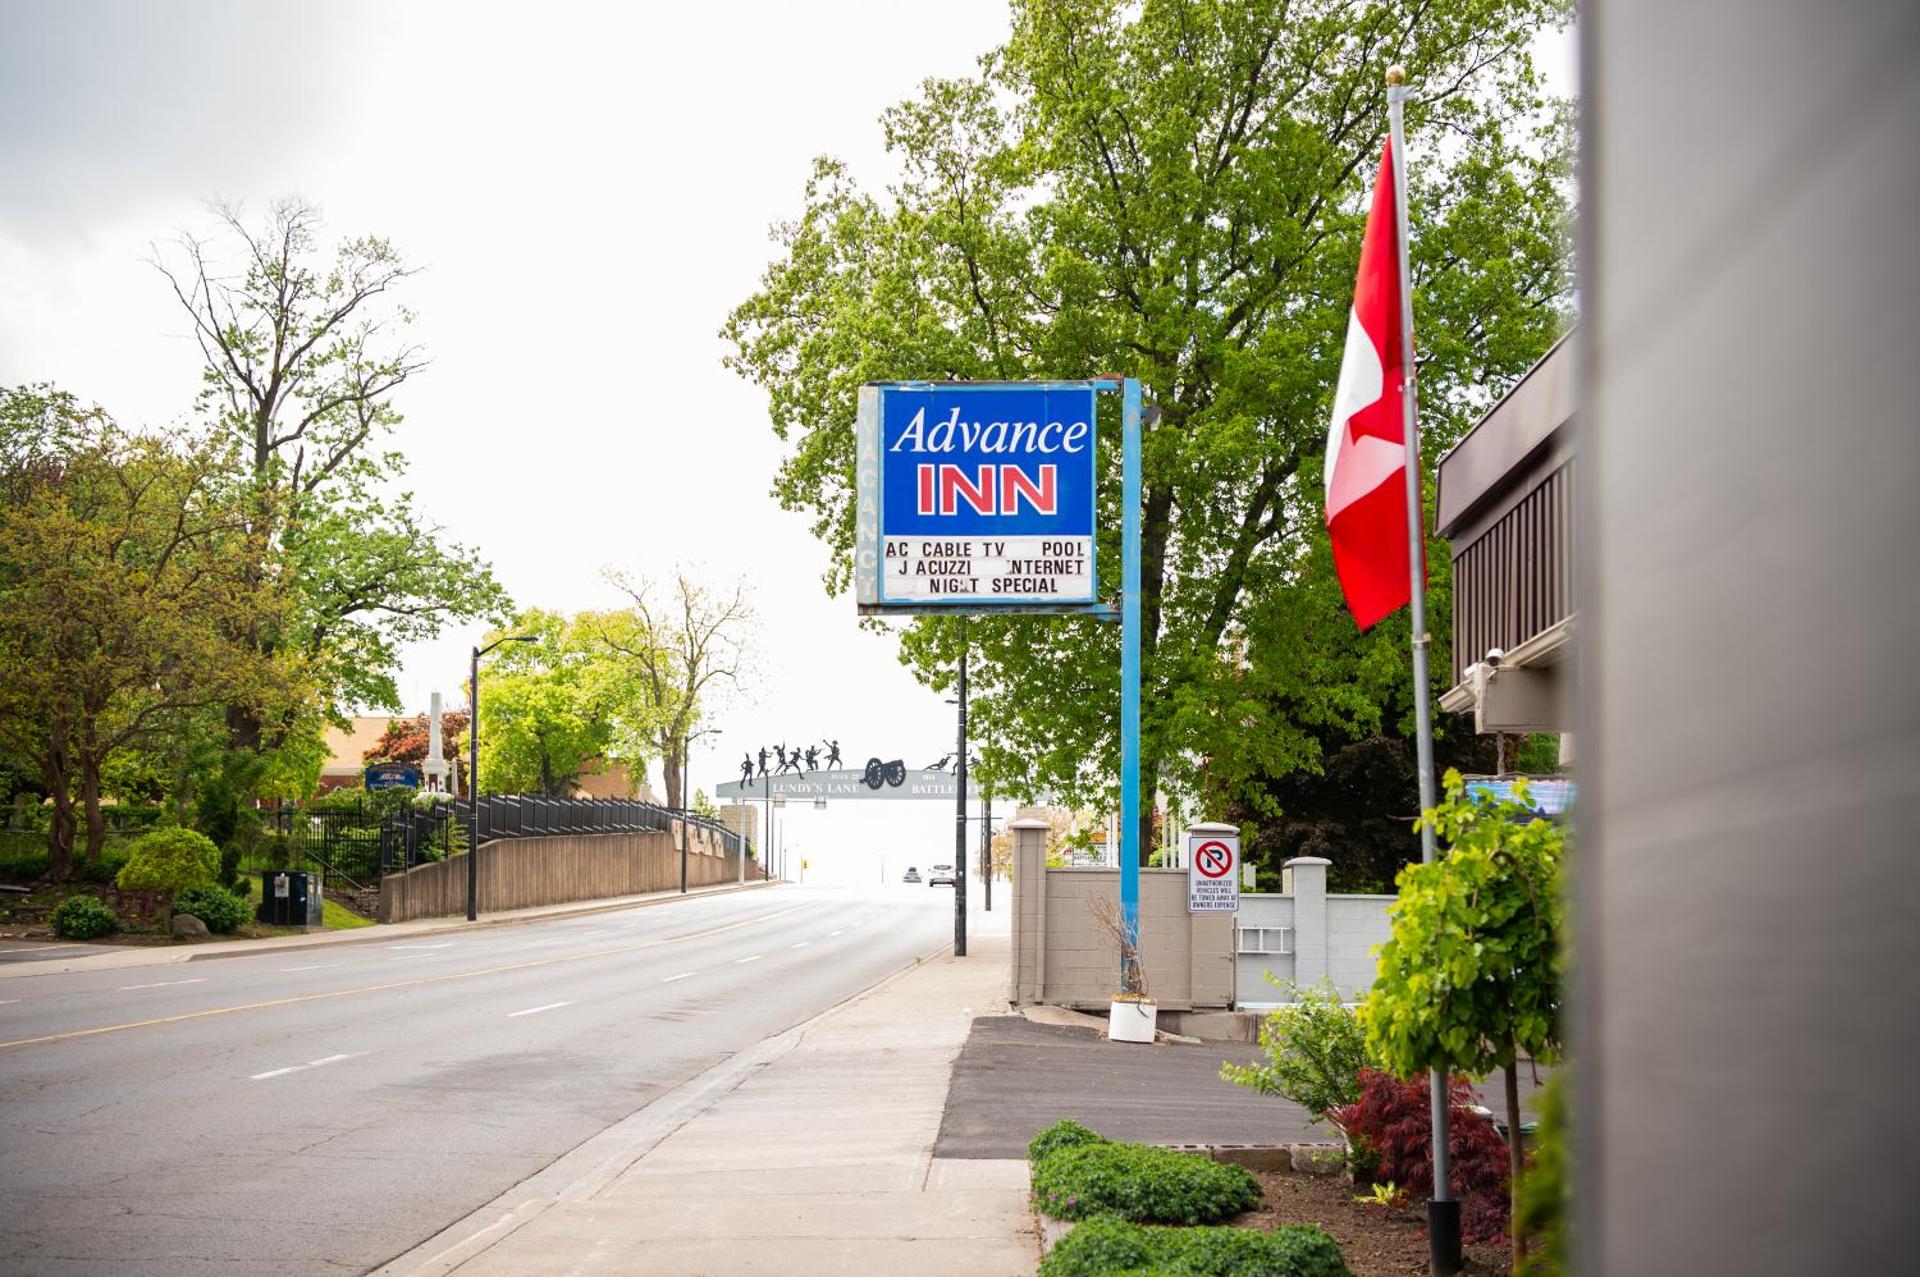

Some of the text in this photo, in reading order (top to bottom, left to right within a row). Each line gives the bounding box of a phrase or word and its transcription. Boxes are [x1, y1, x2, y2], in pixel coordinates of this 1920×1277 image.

[889, 405, 1088, 454] Advance
[917, 463, 1058, 516] INN
[885, 541, 1085, 557] AC CABLE TV POOL
[1006, 559, 1085, 575] NTERNET
[929, 578, 1059, 593] NIGT SPECIAL
[773, 783, 822, 793] LUNDY'S
[827, 783, 859, 793] LANE
